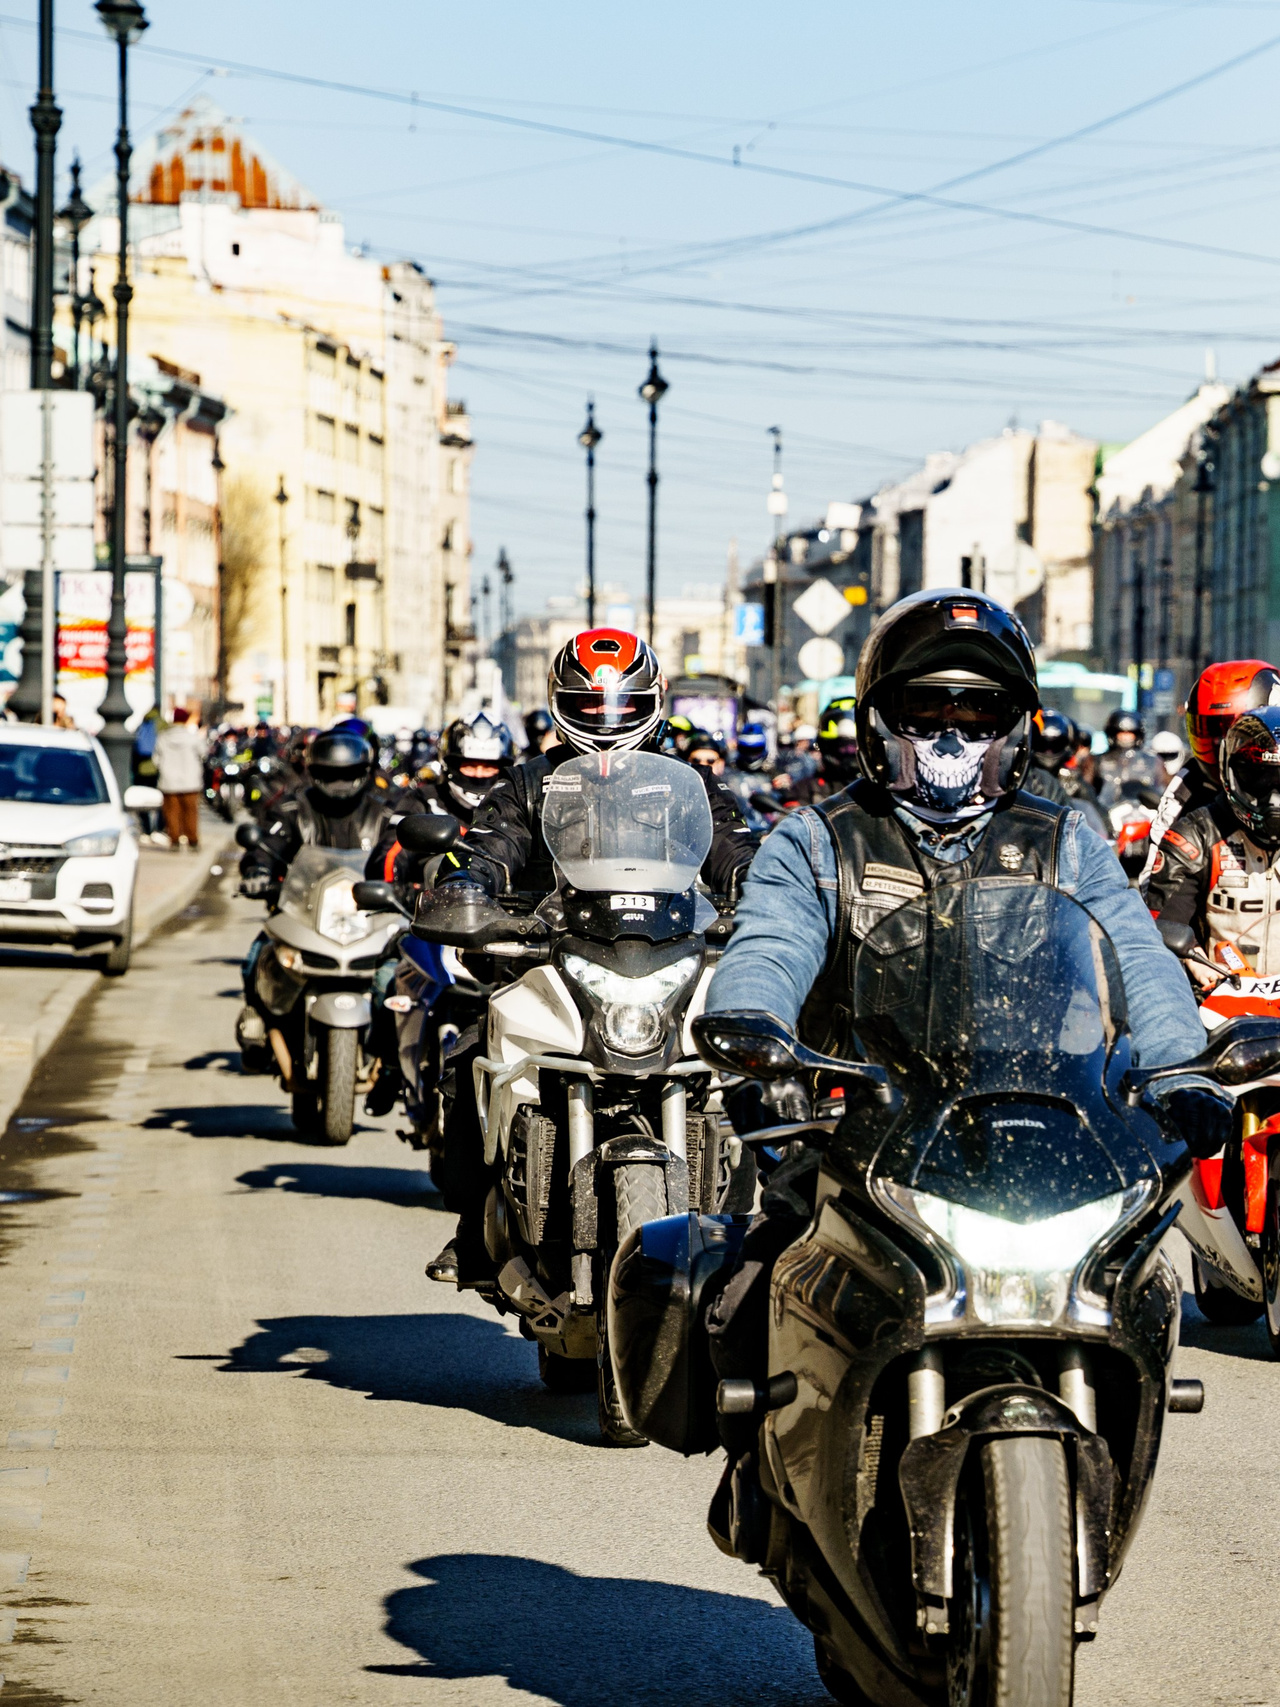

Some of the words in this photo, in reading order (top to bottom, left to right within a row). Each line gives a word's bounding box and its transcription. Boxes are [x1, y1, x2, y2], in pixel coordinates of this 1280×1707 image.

[620, 897, 647, 907] 213
[622, 913, 645, 921] GIVI
[992, 1119, 1046, 1129] HONDA
